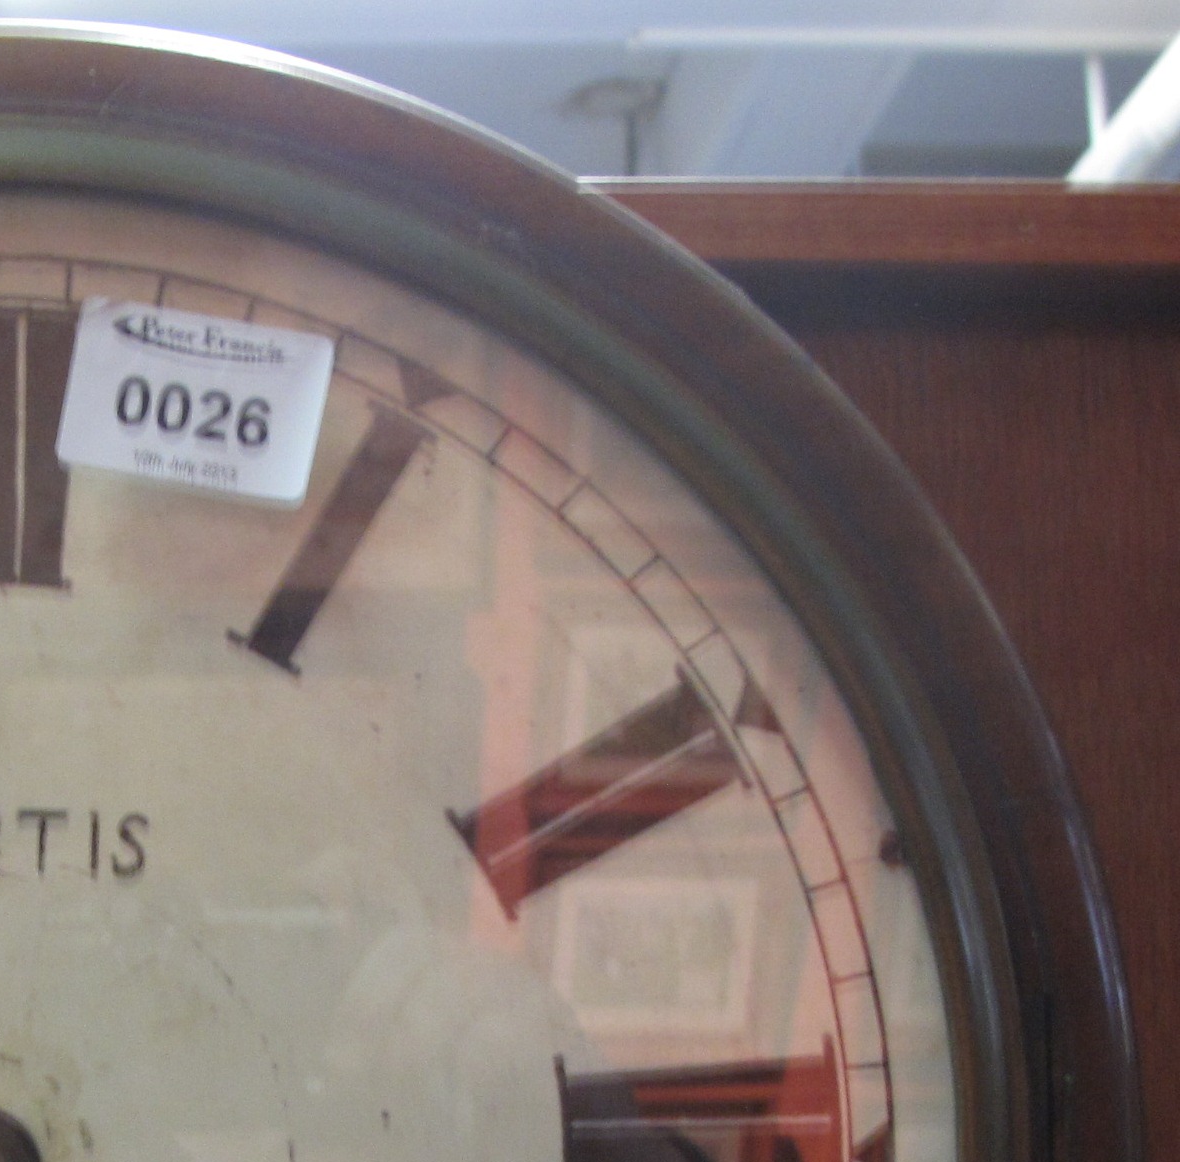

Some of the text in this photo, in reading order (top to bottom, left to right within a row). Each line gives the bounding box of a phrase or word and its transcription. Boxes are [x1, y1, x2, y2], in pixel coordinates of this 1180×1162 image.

[116, 375, 270, 447] 0026
[140, 315, 284, 362] Peter Francis
[226, 400, 437, 678] I
[446, 662, 753, 922] II
